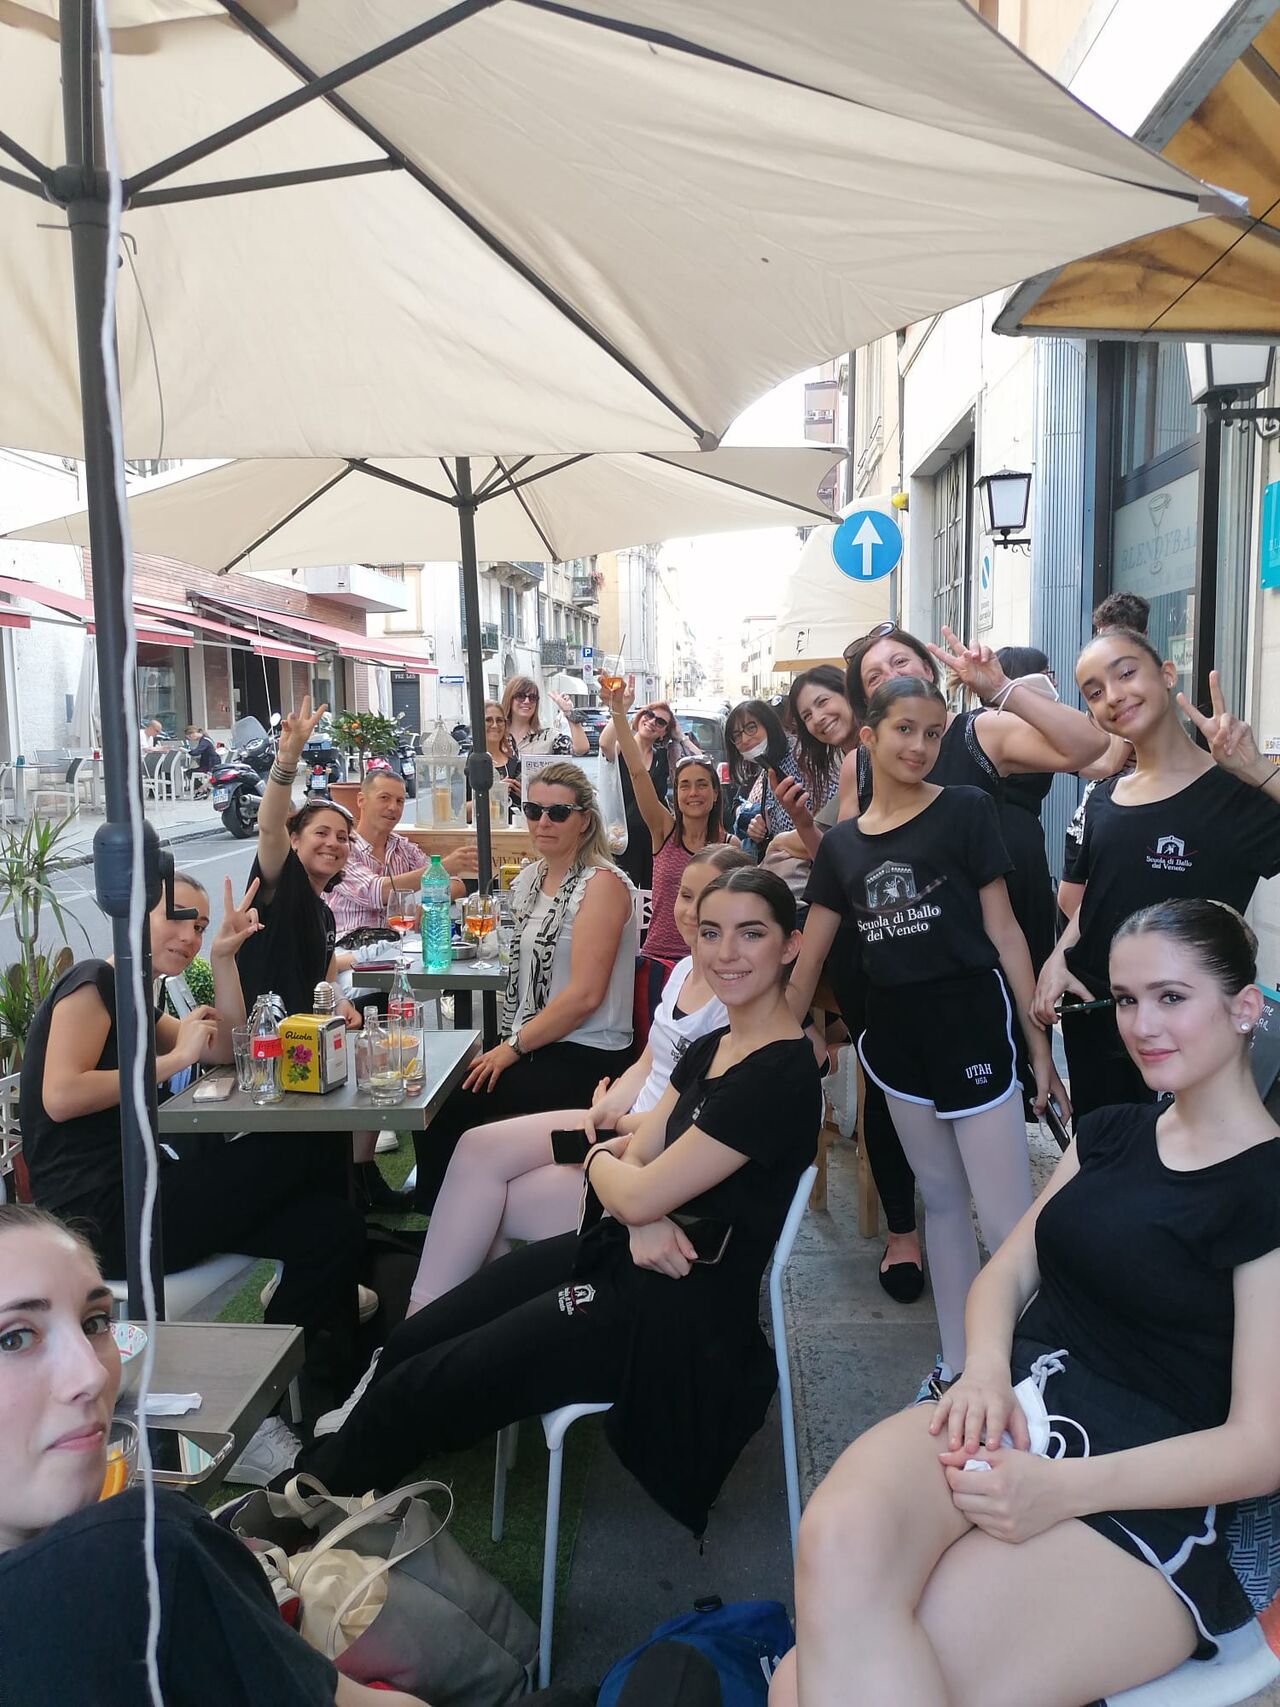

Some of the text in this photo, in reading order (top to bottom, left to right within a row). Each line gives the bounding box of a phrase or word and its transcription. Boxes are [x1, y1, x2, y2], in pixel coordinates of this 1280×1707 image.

[1120, 524, 1196, 573] BLENDYBA
[1146, 855, 1166, 864] Scuola
[1175, 859, 1192, 867] Ballo
[1163, 863, 1185, 872] Veneto
[857, 905, 942, 932] Scuola di Ballo
[867, 922, 929, 942] del Veneto
[285, 1031, 313, 1041] Ricola
[965, 1063, 993, 1079] UTAH
[975, 1076, 988, 1085] USA
